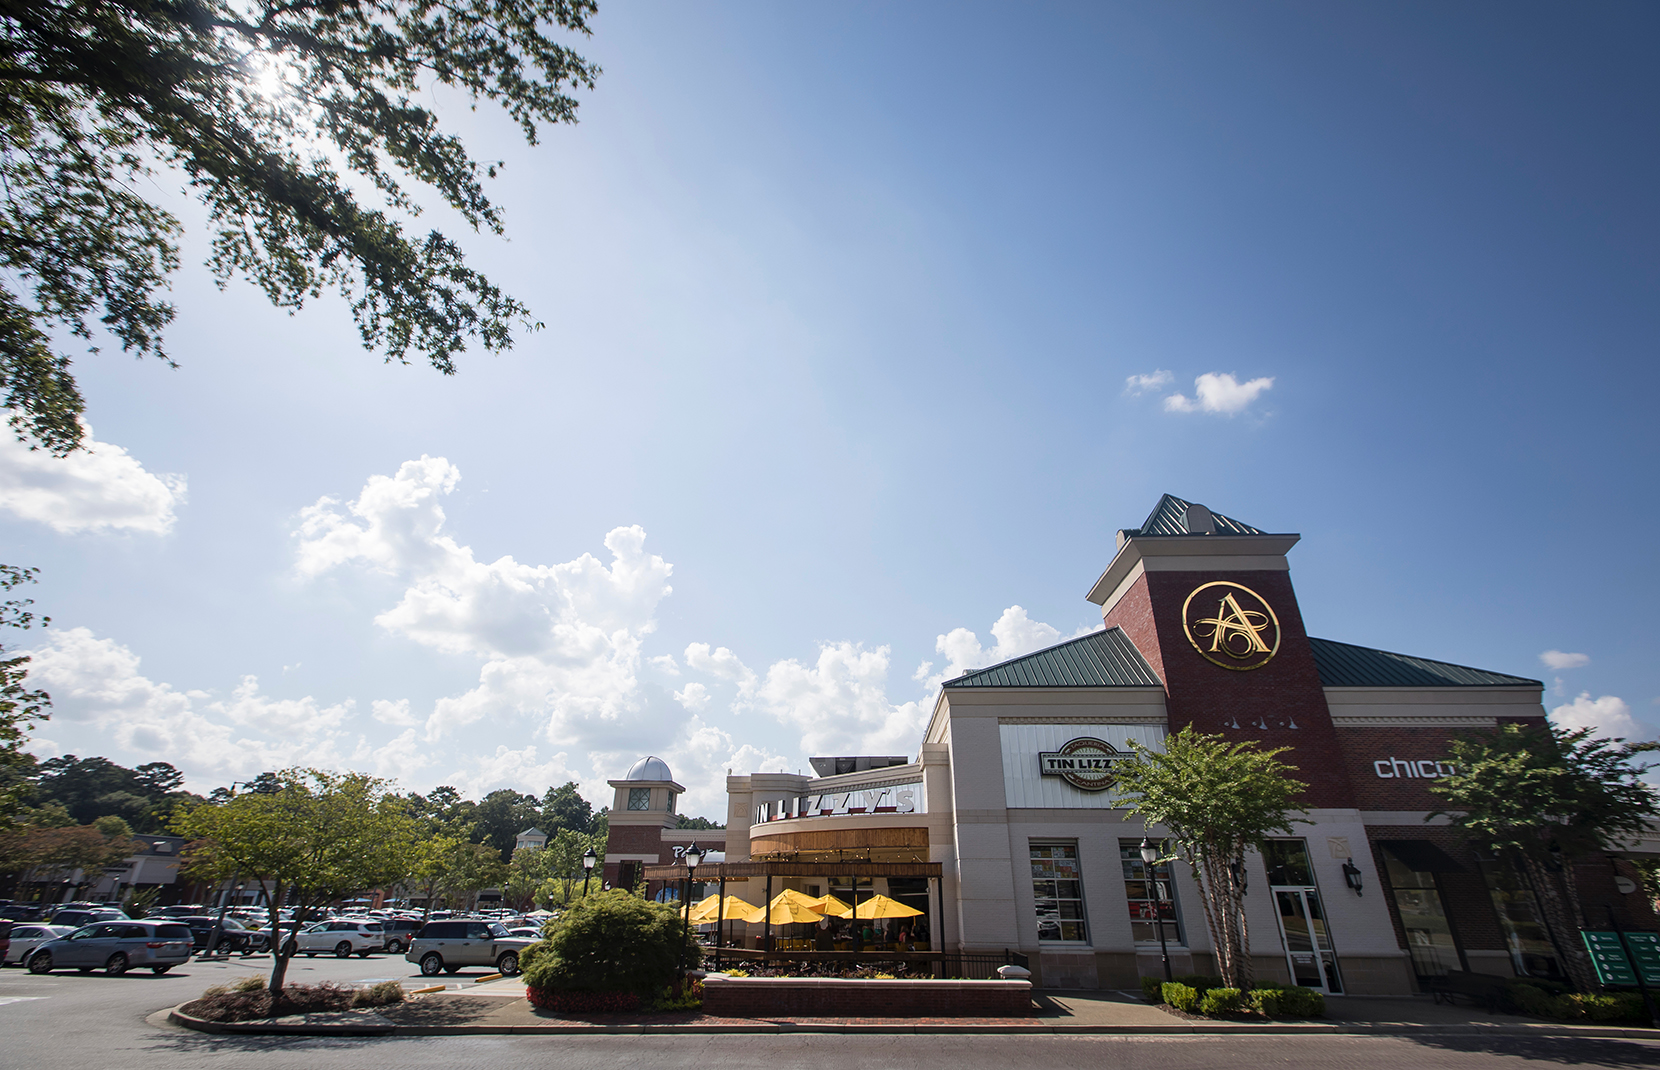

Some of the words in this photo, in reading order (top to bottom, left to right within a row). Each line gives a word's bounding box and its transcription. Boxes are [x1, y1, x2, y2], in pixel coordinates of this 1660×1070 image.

[1071, 740, 1105, 750] TAQUERIA
[1047, 759, 1075, 769] TIN
[1076, 779, 1111, 787] CANTINA
[754, 803, 769, 824] IN
[777, 788, 914, 820] LIZZY'S
